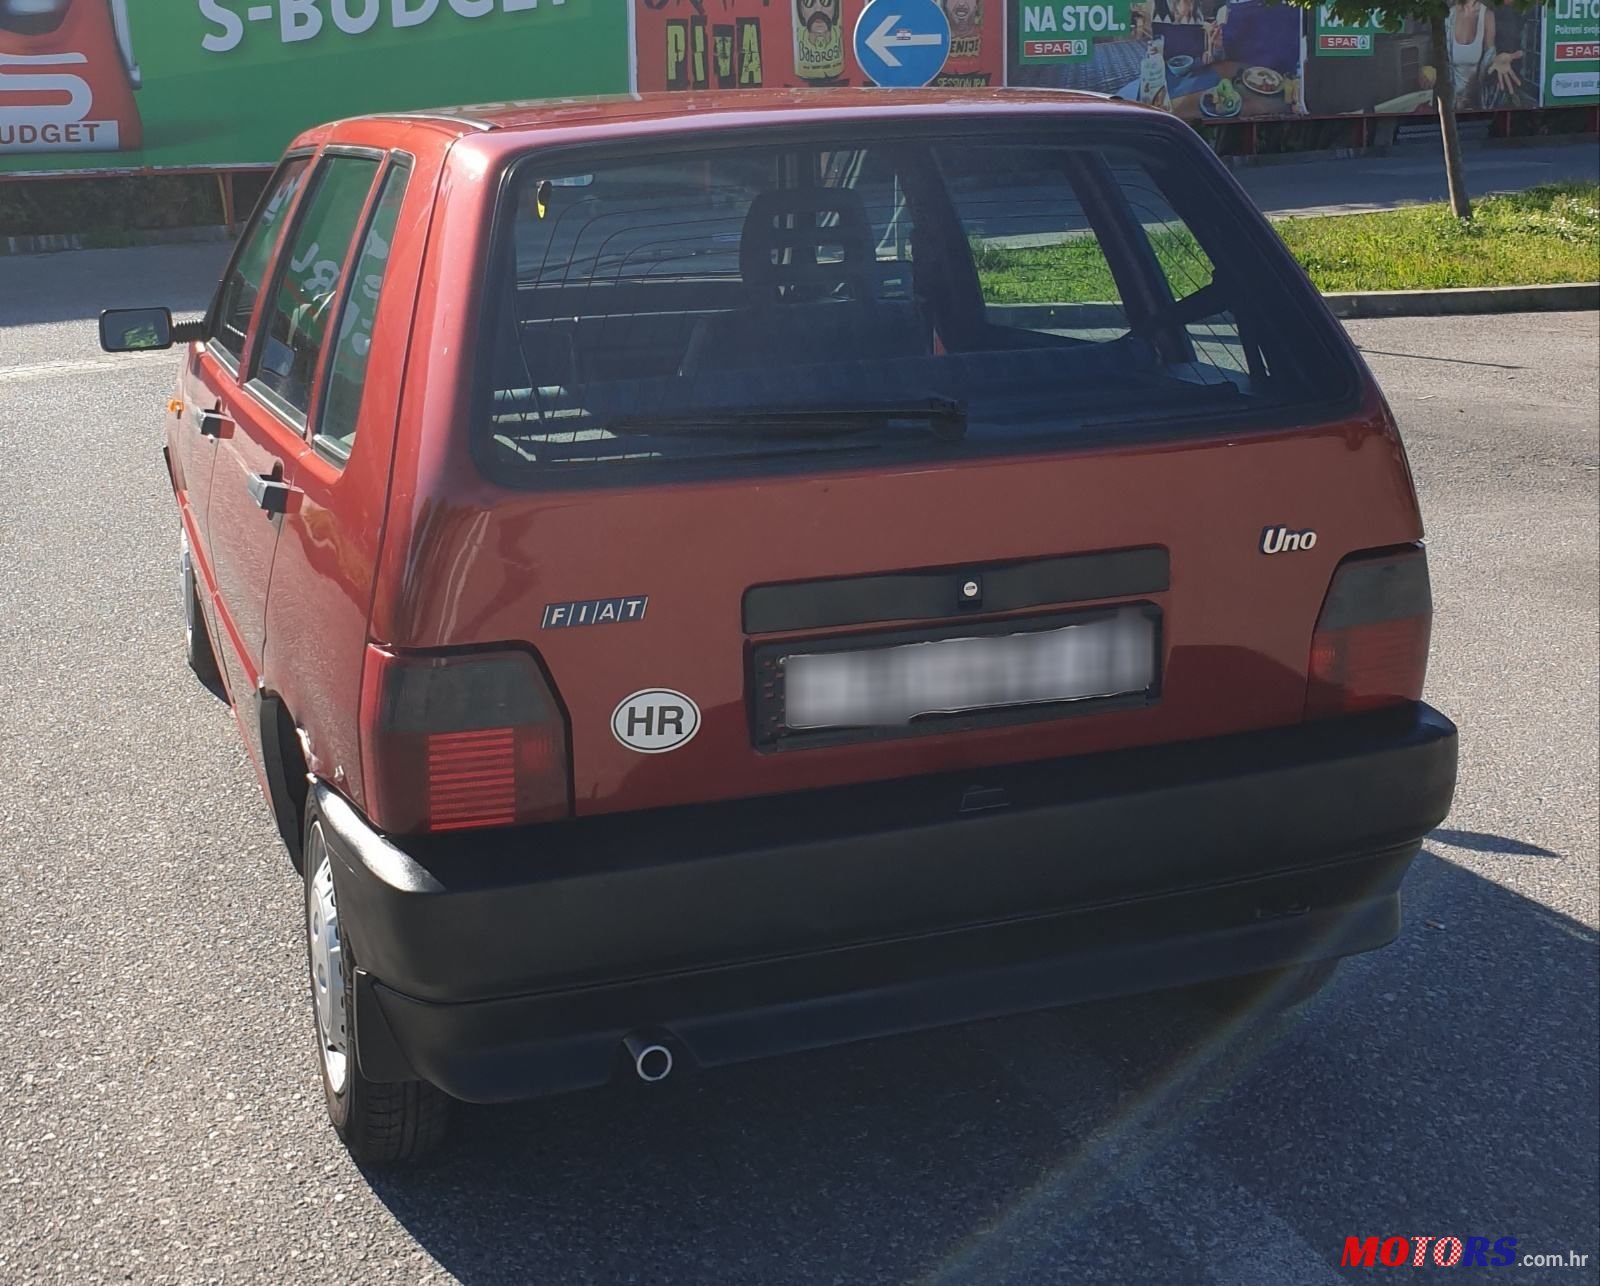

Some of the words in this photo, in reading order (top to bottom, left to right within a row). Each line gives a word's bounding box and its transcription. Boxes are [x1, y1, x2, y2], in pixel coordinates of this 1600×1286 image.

[1024, 6, 1057, 32] NA
[1062, 5, 1126, 31] STOL.
[667, 23, 762, 84] PIVA
[1034, 42, 1072, 54] SPAR
[1327, 37, 1357, 47] SPAR
[1566, 46, 1600, 57] SPAR
[1262, 527, 1317, 554] Uno
[549, 599, 643, 626] FIAT
[627, 705, 684, 737] HR
